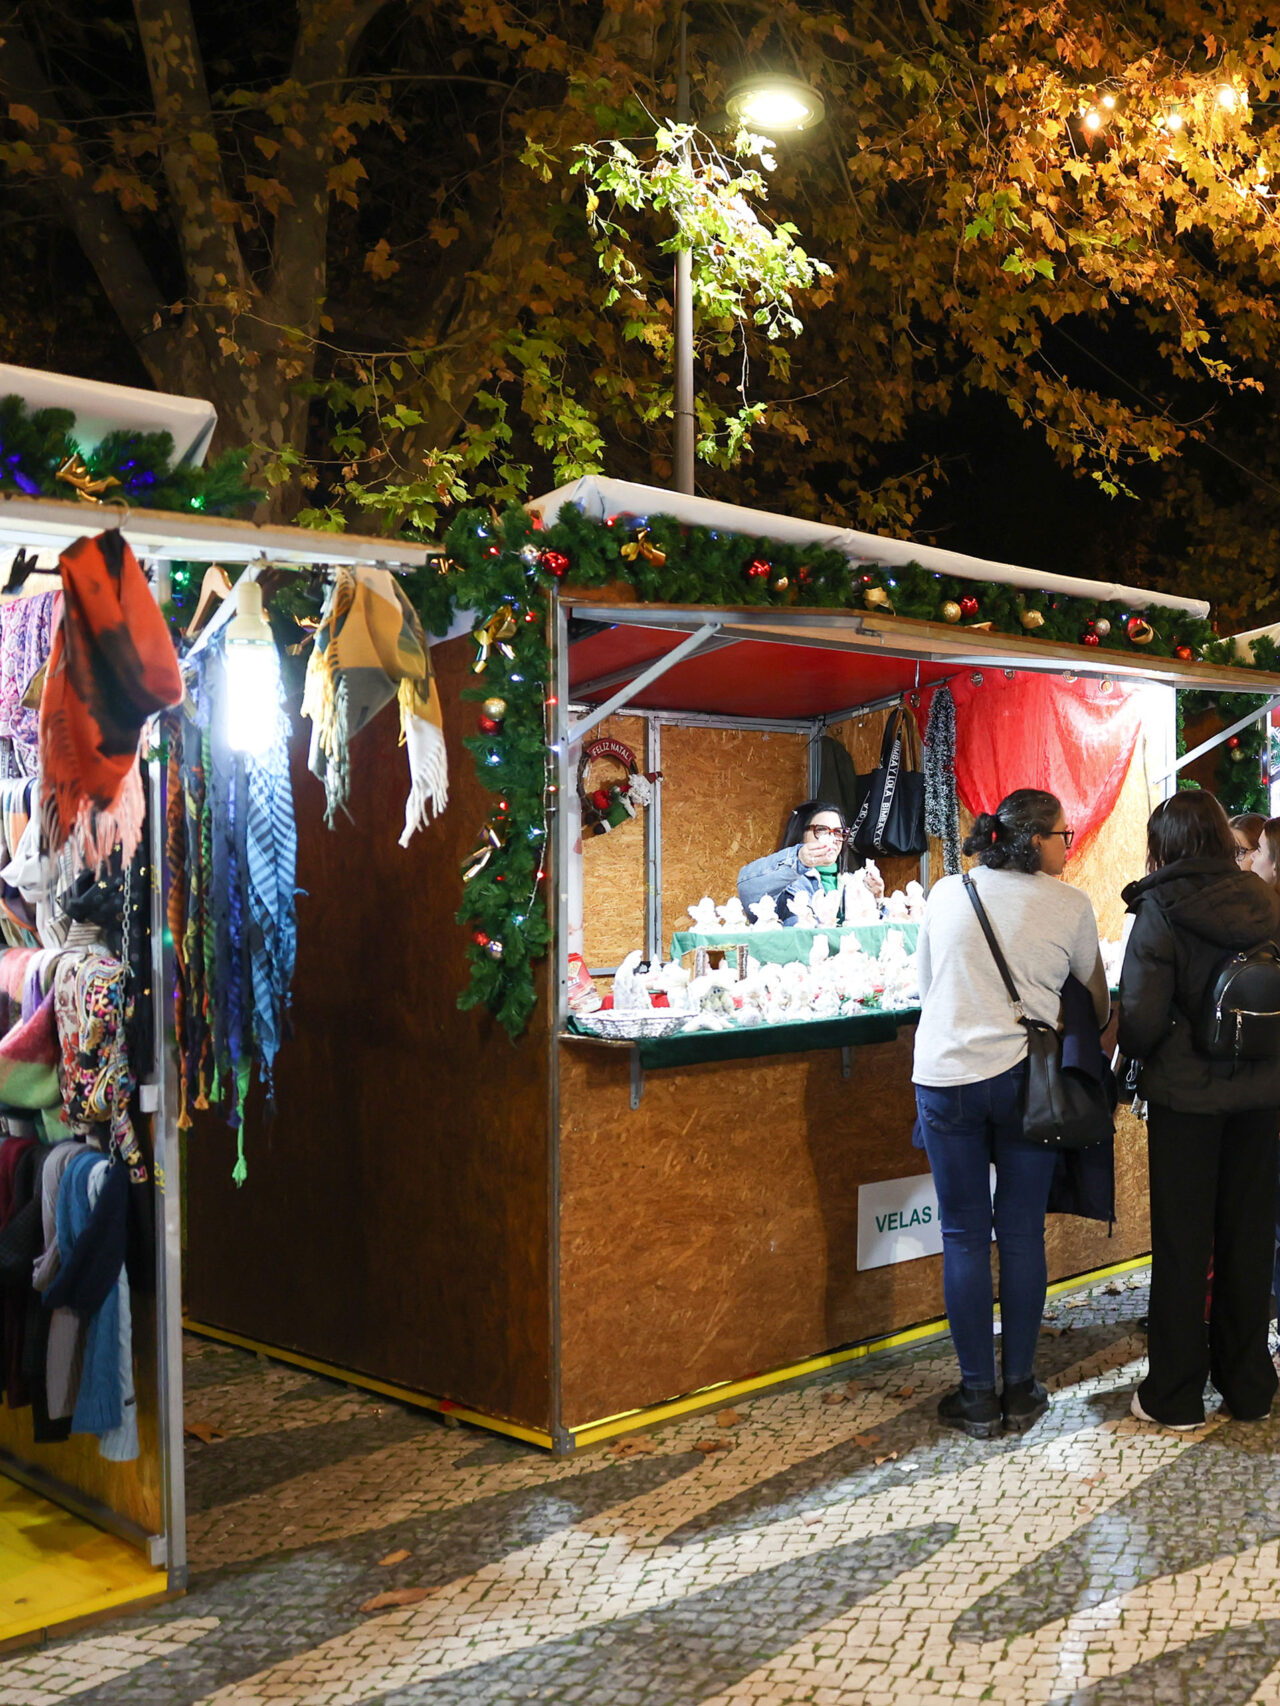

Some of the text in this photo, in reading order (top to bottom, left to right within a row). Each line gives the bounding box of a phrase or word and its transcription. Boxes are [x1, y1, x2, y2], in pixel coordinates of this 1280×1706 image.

[592, 742, 610, 756] FELIZ
[884, 775, 896, 797] LOLA
[875, 1206, 932, 1233] VELAS
